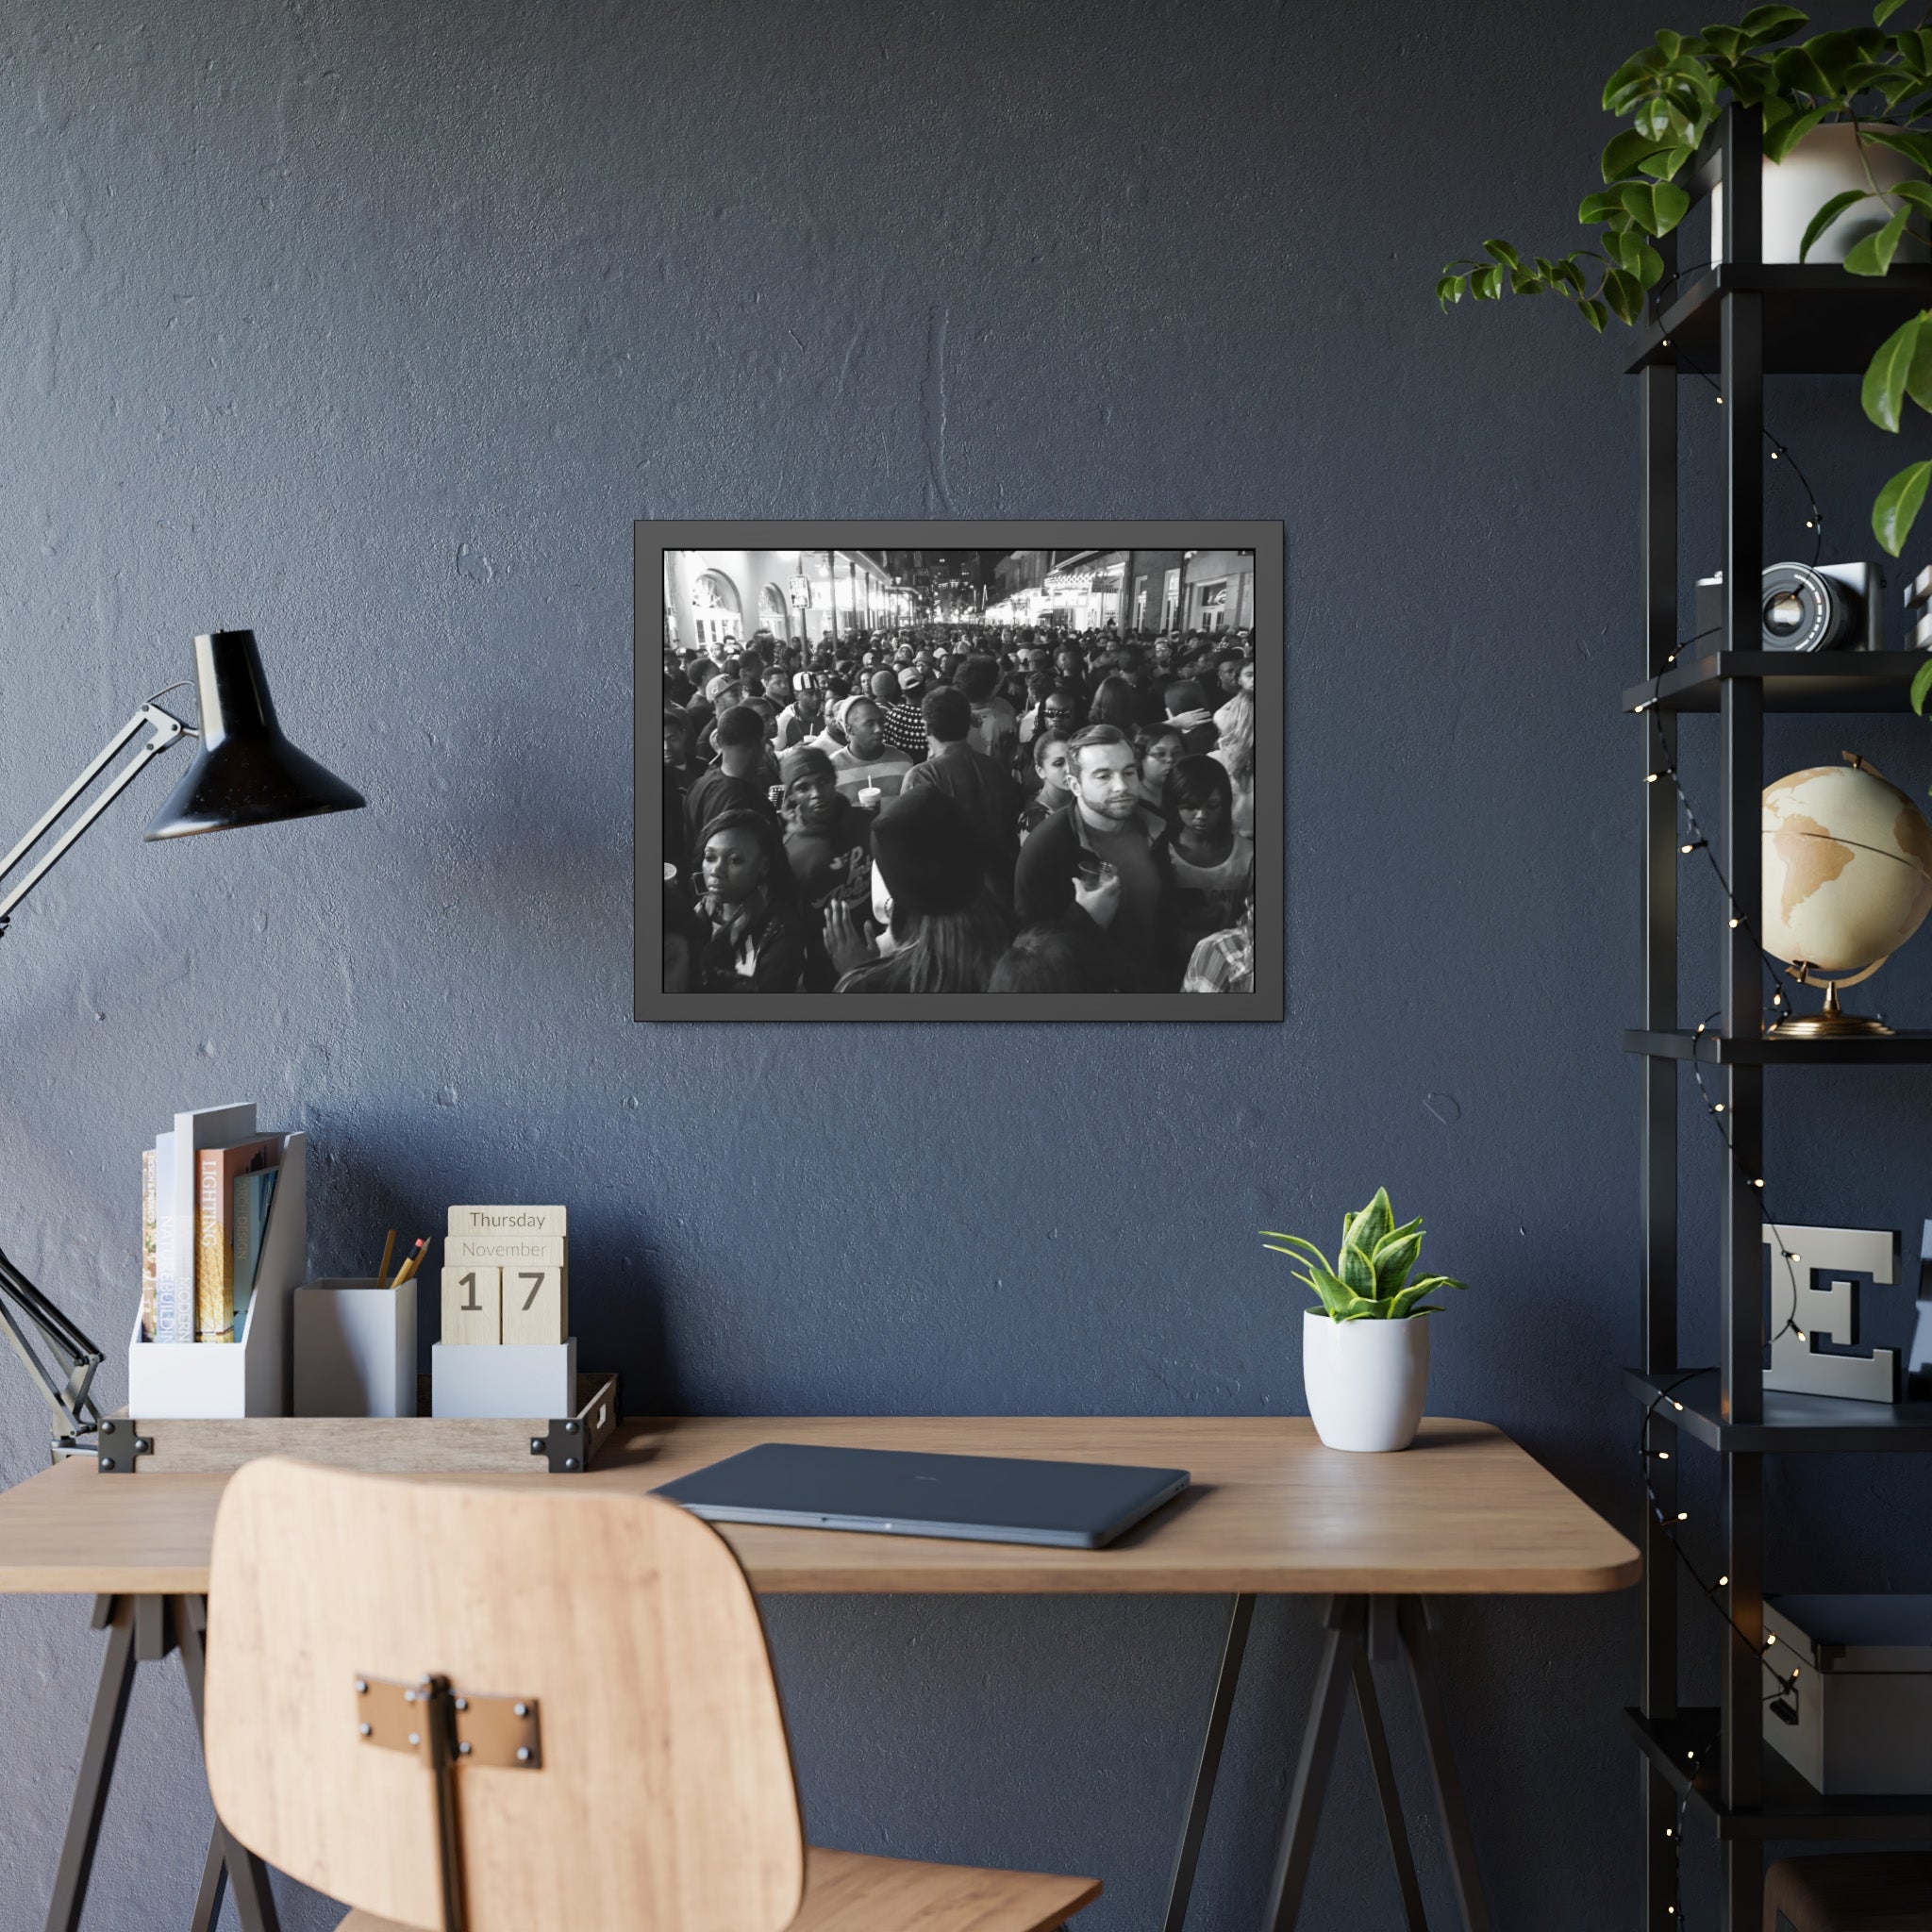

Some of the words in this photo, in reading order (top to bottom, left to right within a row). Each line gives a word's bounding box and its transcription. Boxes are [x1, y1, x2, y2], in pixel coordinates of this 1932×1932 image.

[147, 1155, 156, 1183] DESIGN
[202, 1161, 217, 1247] LIGHTING
[469, 1212, 546, 1230] Thursday
[237, 1216, 248, 1259] DESIGN
[462, 1241, 547, 1257] November
[177, 1277, 191, 1342] MODERN
